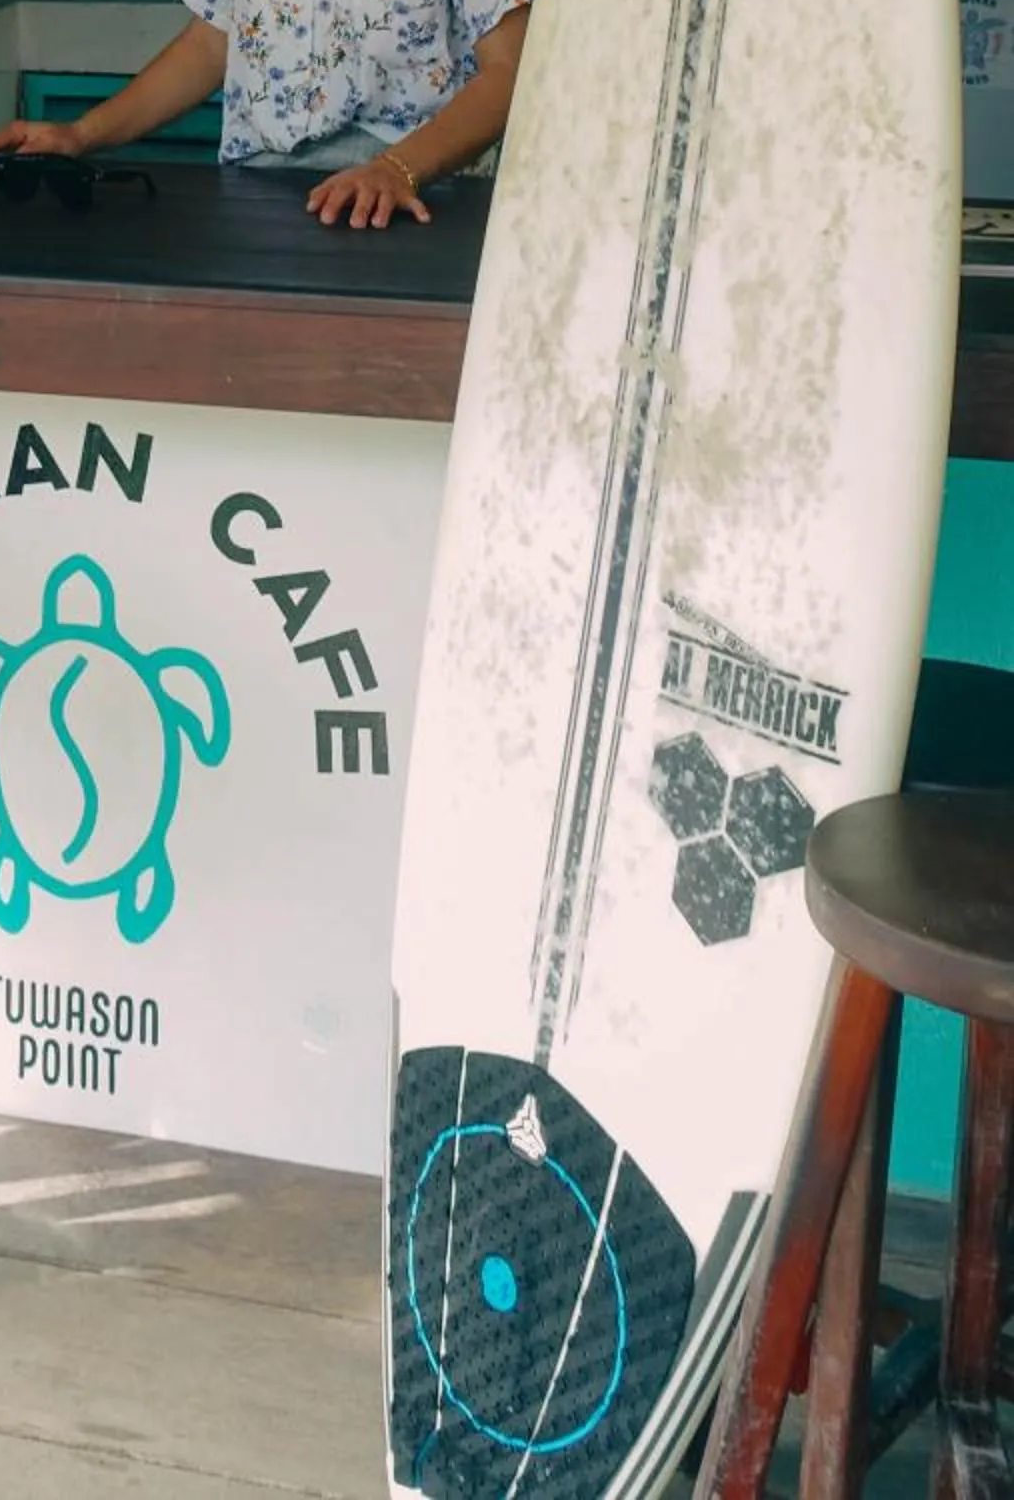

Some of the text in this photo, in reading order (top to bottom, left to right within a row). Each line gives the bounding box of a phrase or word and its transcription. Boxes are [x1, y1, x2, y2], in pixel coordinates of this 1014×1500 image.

[209, 491, 391, 776] CAFE
[703, 653, 842, 752] MERRICK
[18, 1034, 123, 1096] POINT
